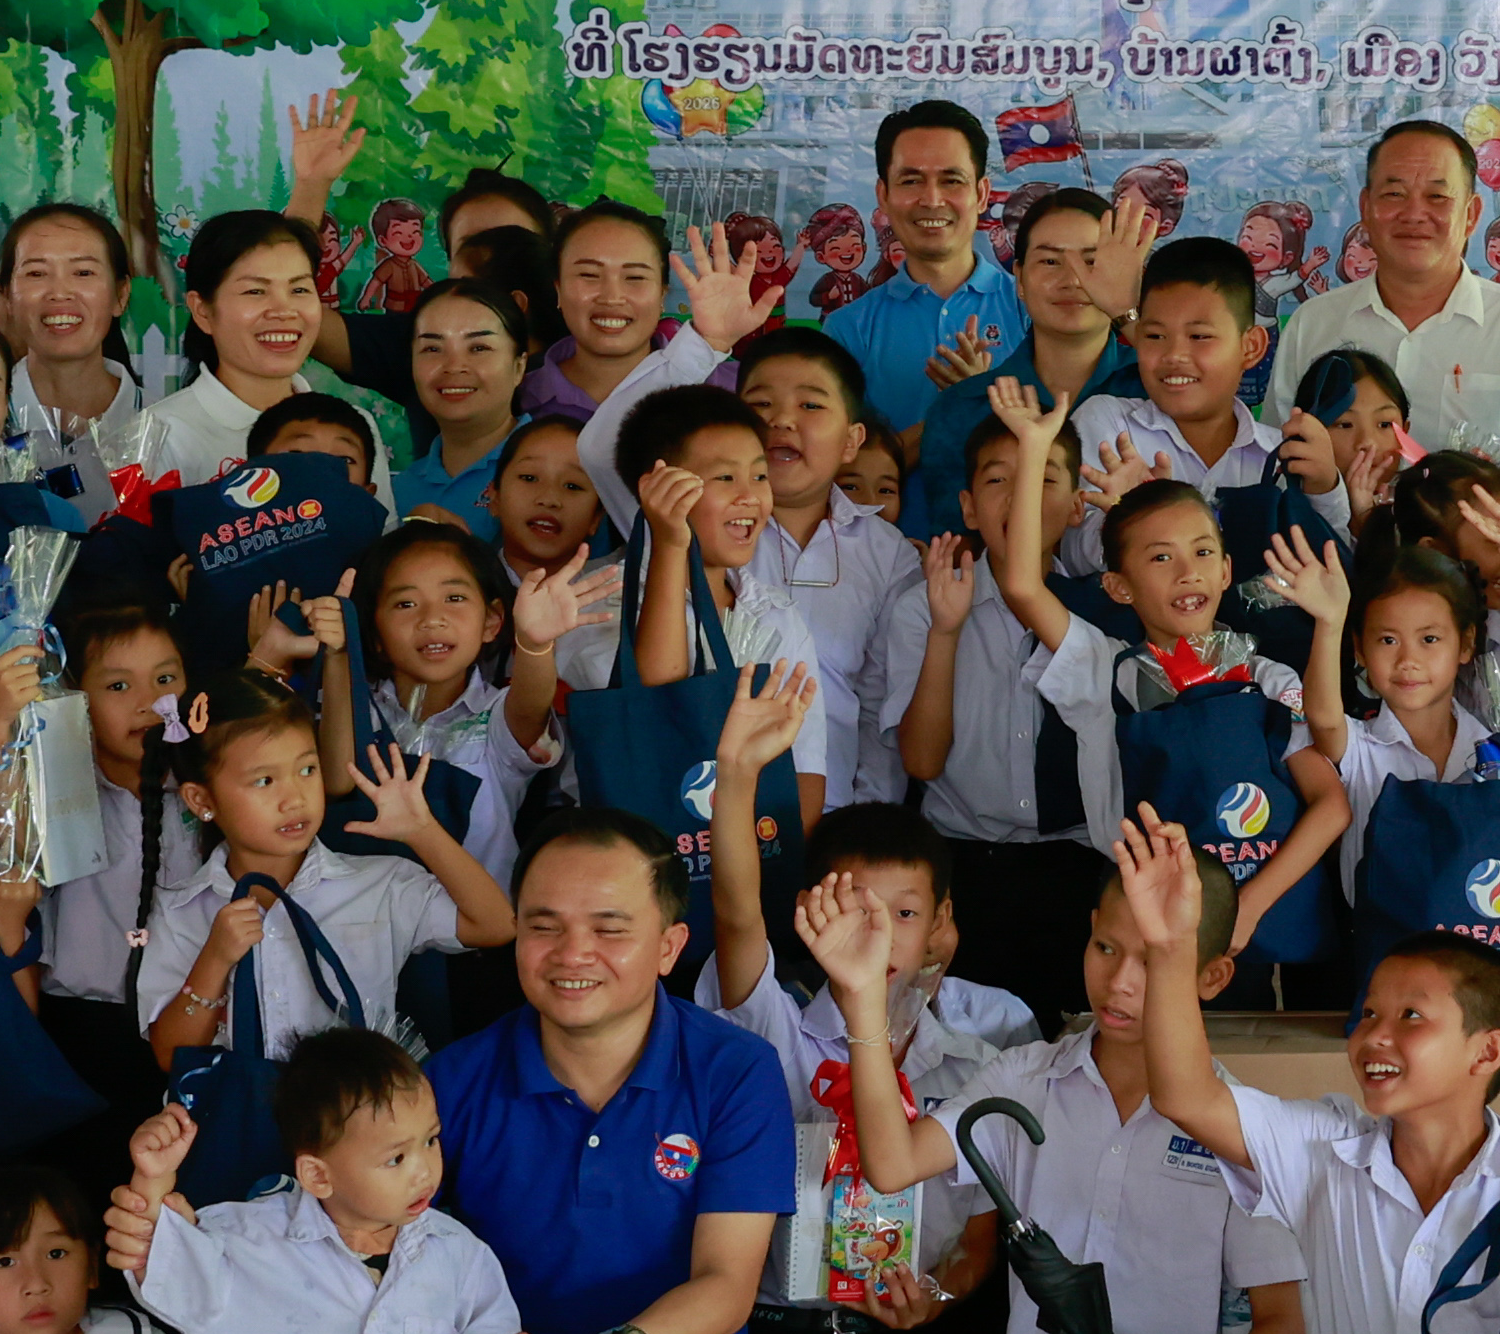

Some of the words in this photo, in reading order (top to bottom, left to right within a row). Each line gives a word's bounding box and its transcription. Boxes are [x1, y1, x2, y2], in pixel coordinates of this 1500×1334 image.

[684, 97, 721, 111] 2026
[199, 504, 297, 553] ASEAN
[200, 546, 239, 572] LAO
[241, 531, 280, 557] PDR
[281, 517, 327, 543] 2024
